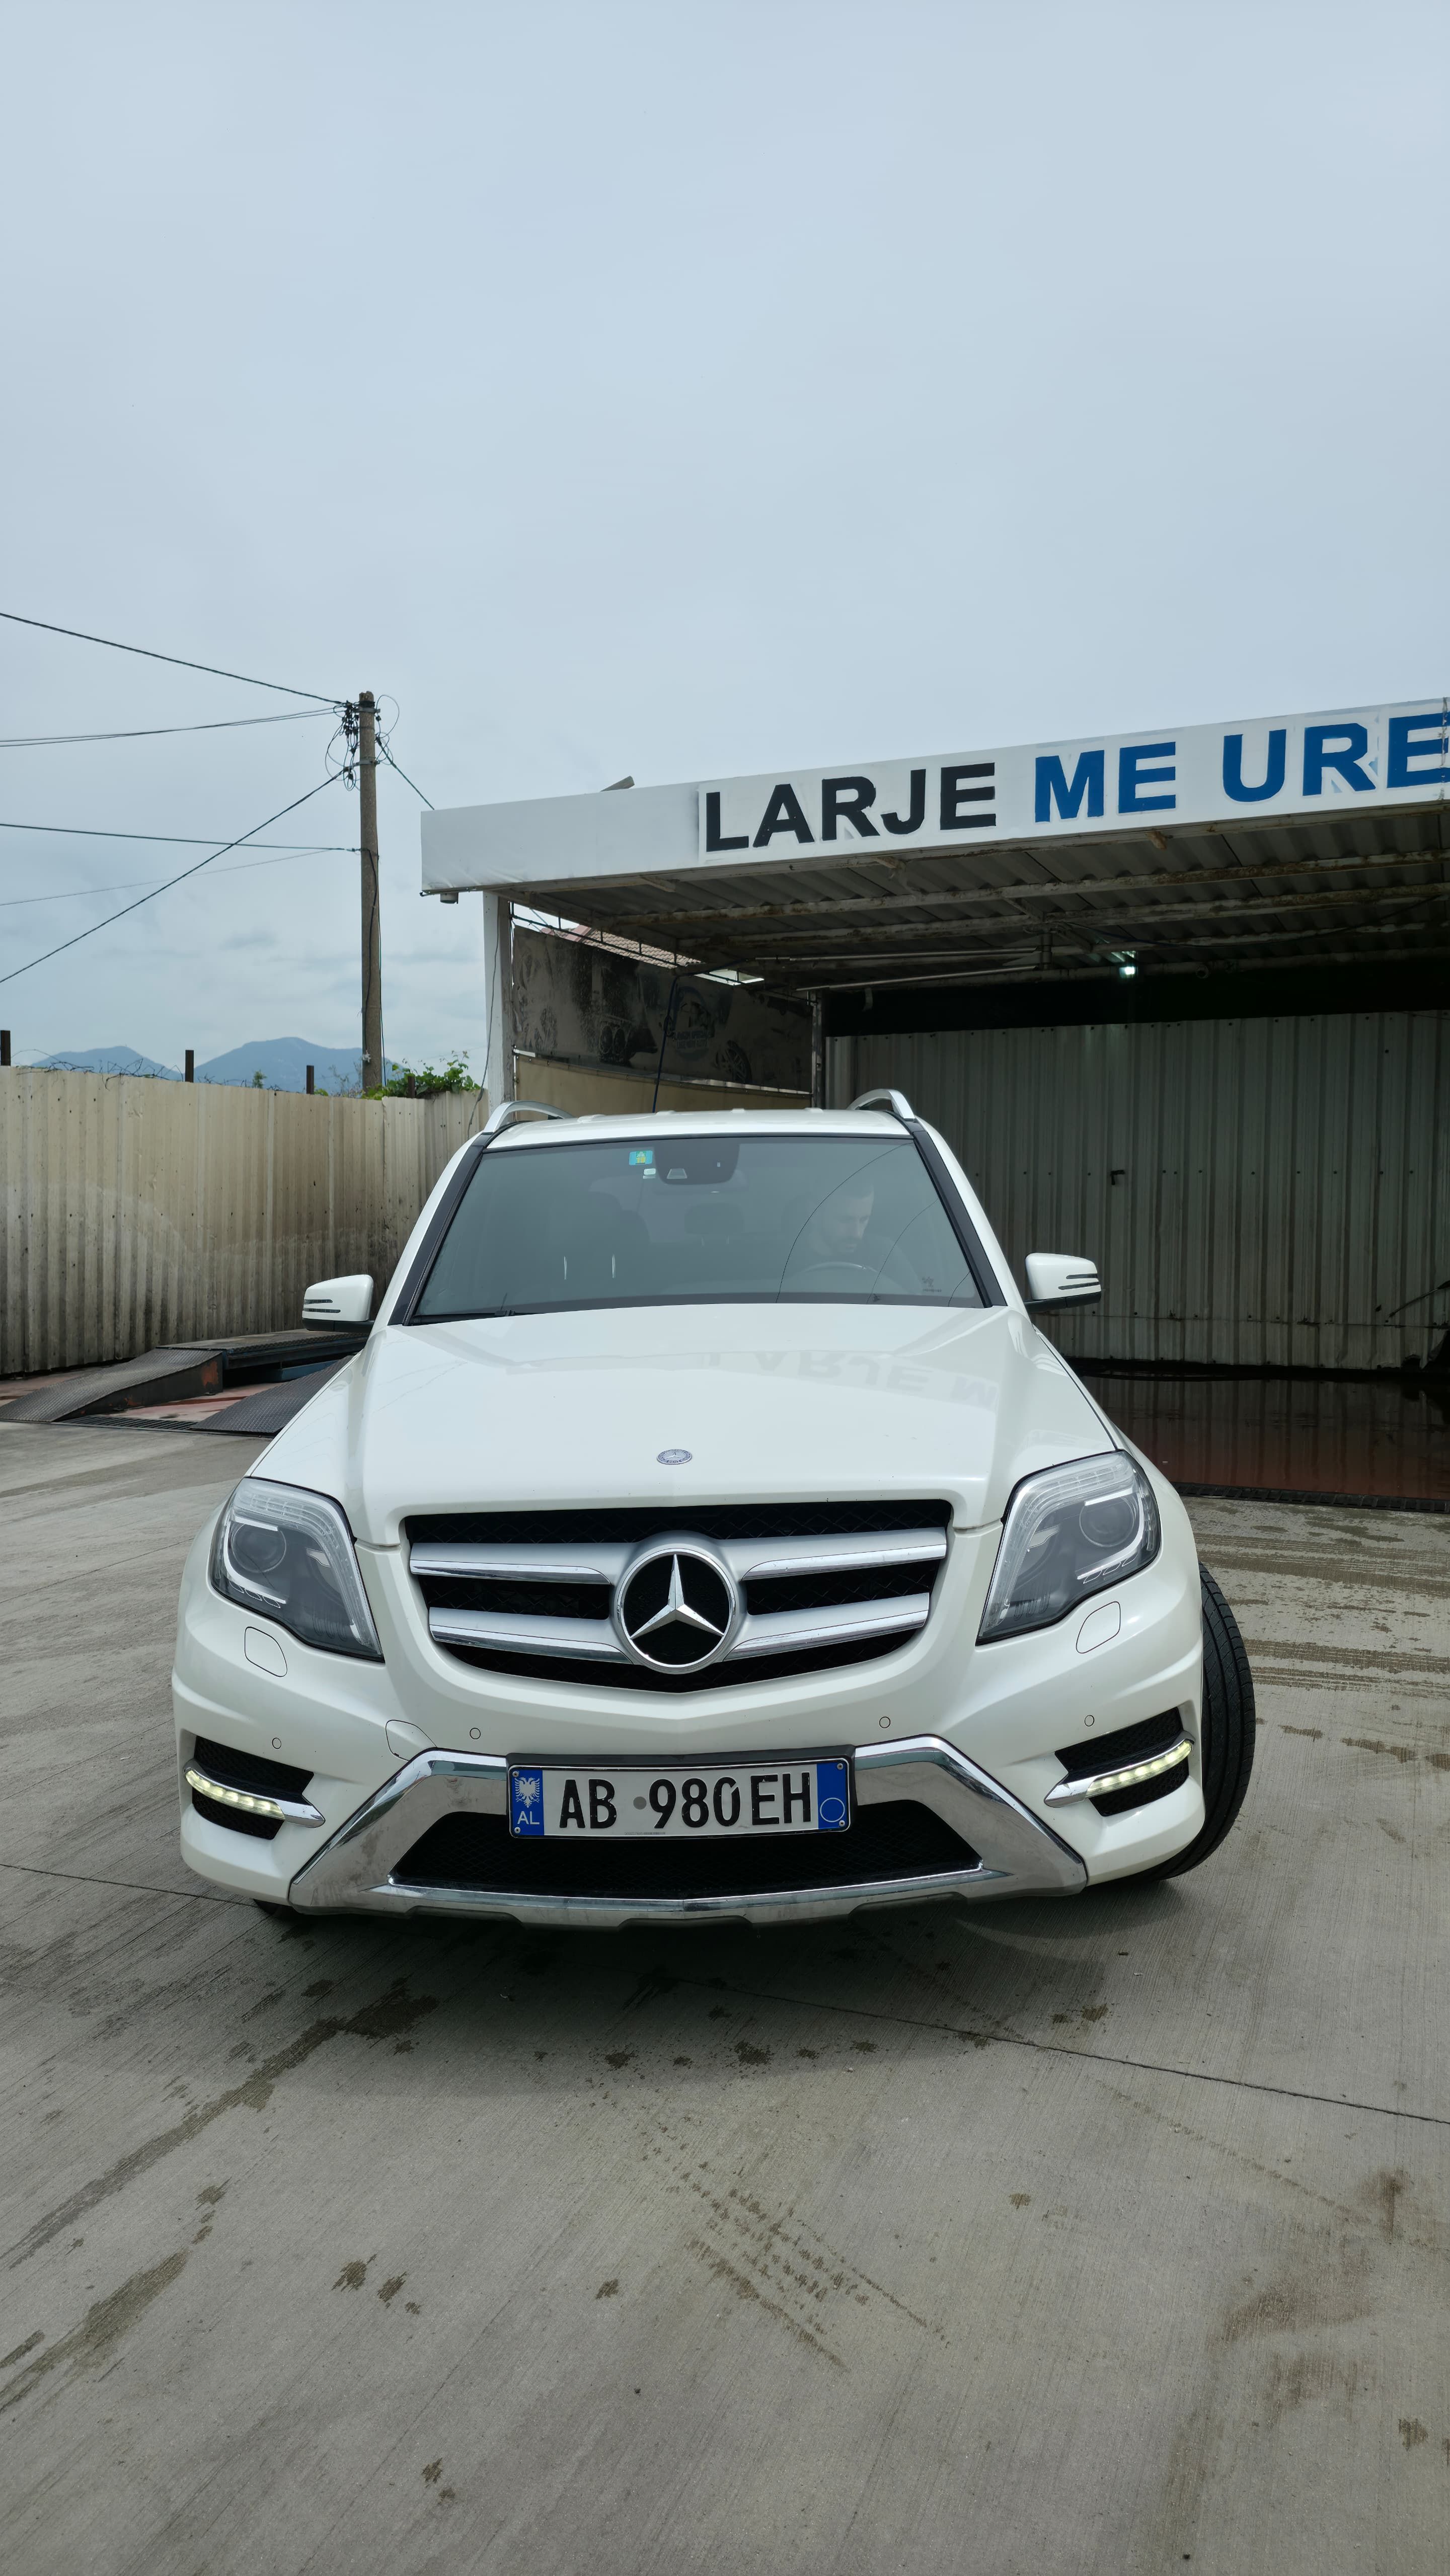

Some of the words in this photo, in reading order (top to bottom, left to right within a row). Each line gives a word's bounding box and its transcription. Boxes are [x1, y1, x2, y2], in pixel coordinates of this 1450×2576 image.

[706, 762, 997, 852] LARJE
[1034, 742, 1177, 823] ME
[1223, 711, 1450, 802] URE
[517, 1811, 540, 1825] AL
[559, 1779, 617, 1829] AB
